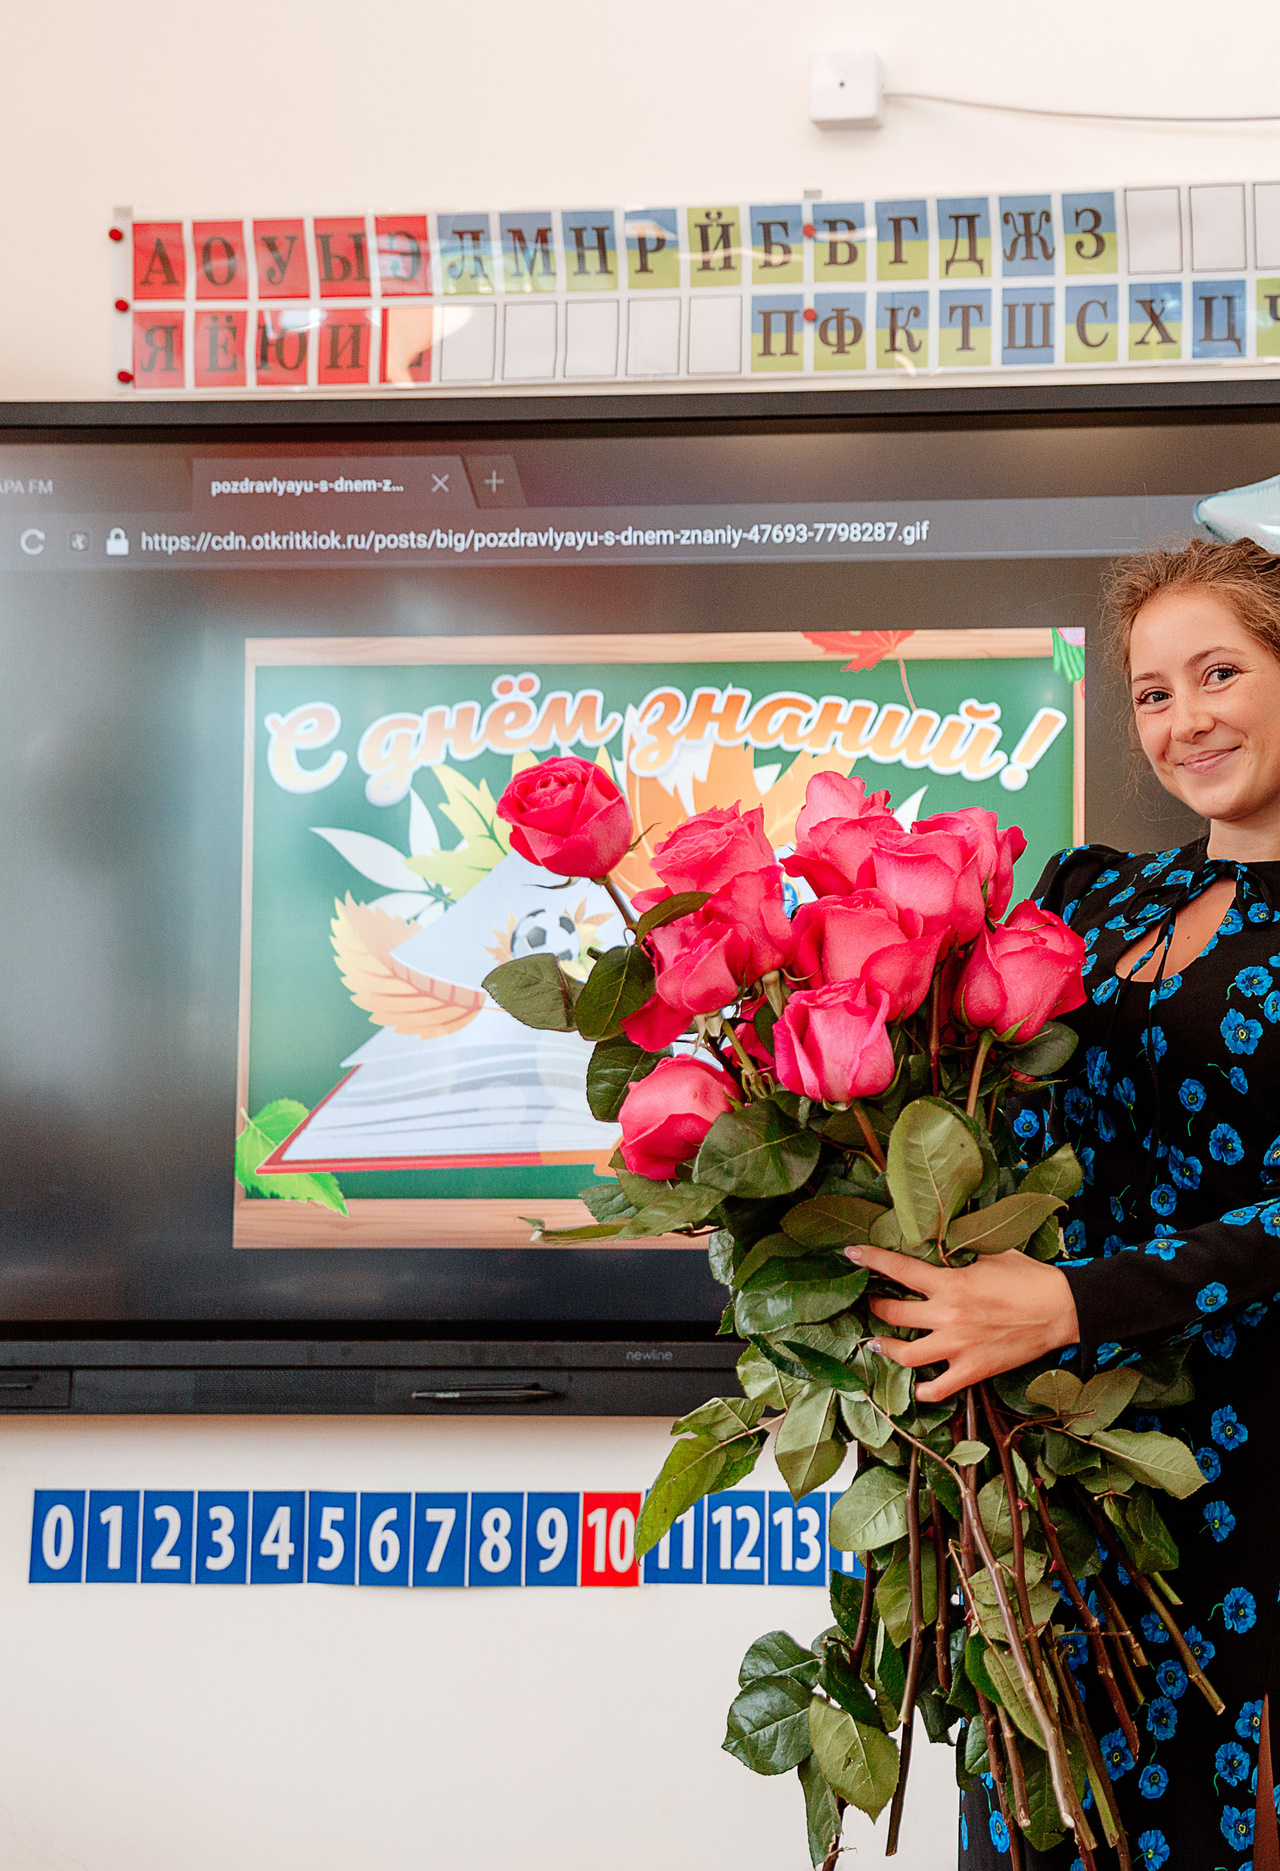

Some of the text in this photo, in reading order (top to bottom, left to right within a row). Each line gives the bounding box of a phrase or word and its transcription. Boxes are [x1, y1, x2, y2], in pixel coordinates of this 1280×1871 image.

[140, 237, 180, 286] А
[202, 236, 237, 286] О
[261, 235, 298, 285] У
[317, 232, 370, 282] Ы
[388, 230, 421, 281] Э
[448, 229, 488, 280] Л
[507, 227, 556, 277] М
[569, 226, 614, 275] Н
[635, 223, 667, 274] Р
[695, 210, 736, 272] Й
[757, 220, 792, 269] Б
[823, 218, 858, 266] В
[888, 216, 919, 264] Г
[945, 213, 984, 276] Д
[1003, 209, 1056, 261] Ж
[1075, 208, 1106, 259] З
[140, 325, 178, 373] Я
[205, 315, 238, 372] Ё
[257, 322, 308, 371] Ю
[325, 324, 366, 369] И
[758, 310, 799, 357] П
[818, 307, 863, 355] Ф
[885, 306, 922, 353] К
[949, 304, 983, 350] Т
[1003, 303, 1054, 349] Ш
[1076, 300, 1109, 348] С
[1135, 299, 1177, 346] Х
[1199, 295, 1241, 353] Ц
[29, 479, 53, 494] FM
[211, 476, 404, 497] pozdravlyayu-s-dnem-z...
[141, 520, 930, 555] https://cdn.otkritkiok.ru/posts/big/pozdravlyayu-s-dnem-znaniy-47693-7798287.gif
[265, 678, 1067, 806] С днём знаний!
[626, 1349, 673, 1360] newline
[42, 1504, 74, 1570] 0
[100, 1505, 122, 1569] 1
[151, 1505, 181, 1569] 2
[205, 1505, 235, 1570] 3
[260, 1506, 294, 1569] 4
[317, 1506, 344, 1570] 5
[369, 1507, 400, 1572] 6
[426, 1508, 456, 1572] 7
[479, 1507, 512, 1572] 8
[536, 1507, 568, 1572] 9
[587, 1507, 636, 1572] 10
[711, 1505, 761, 1570] 12
[772, 1506, 821, 1572] 13
